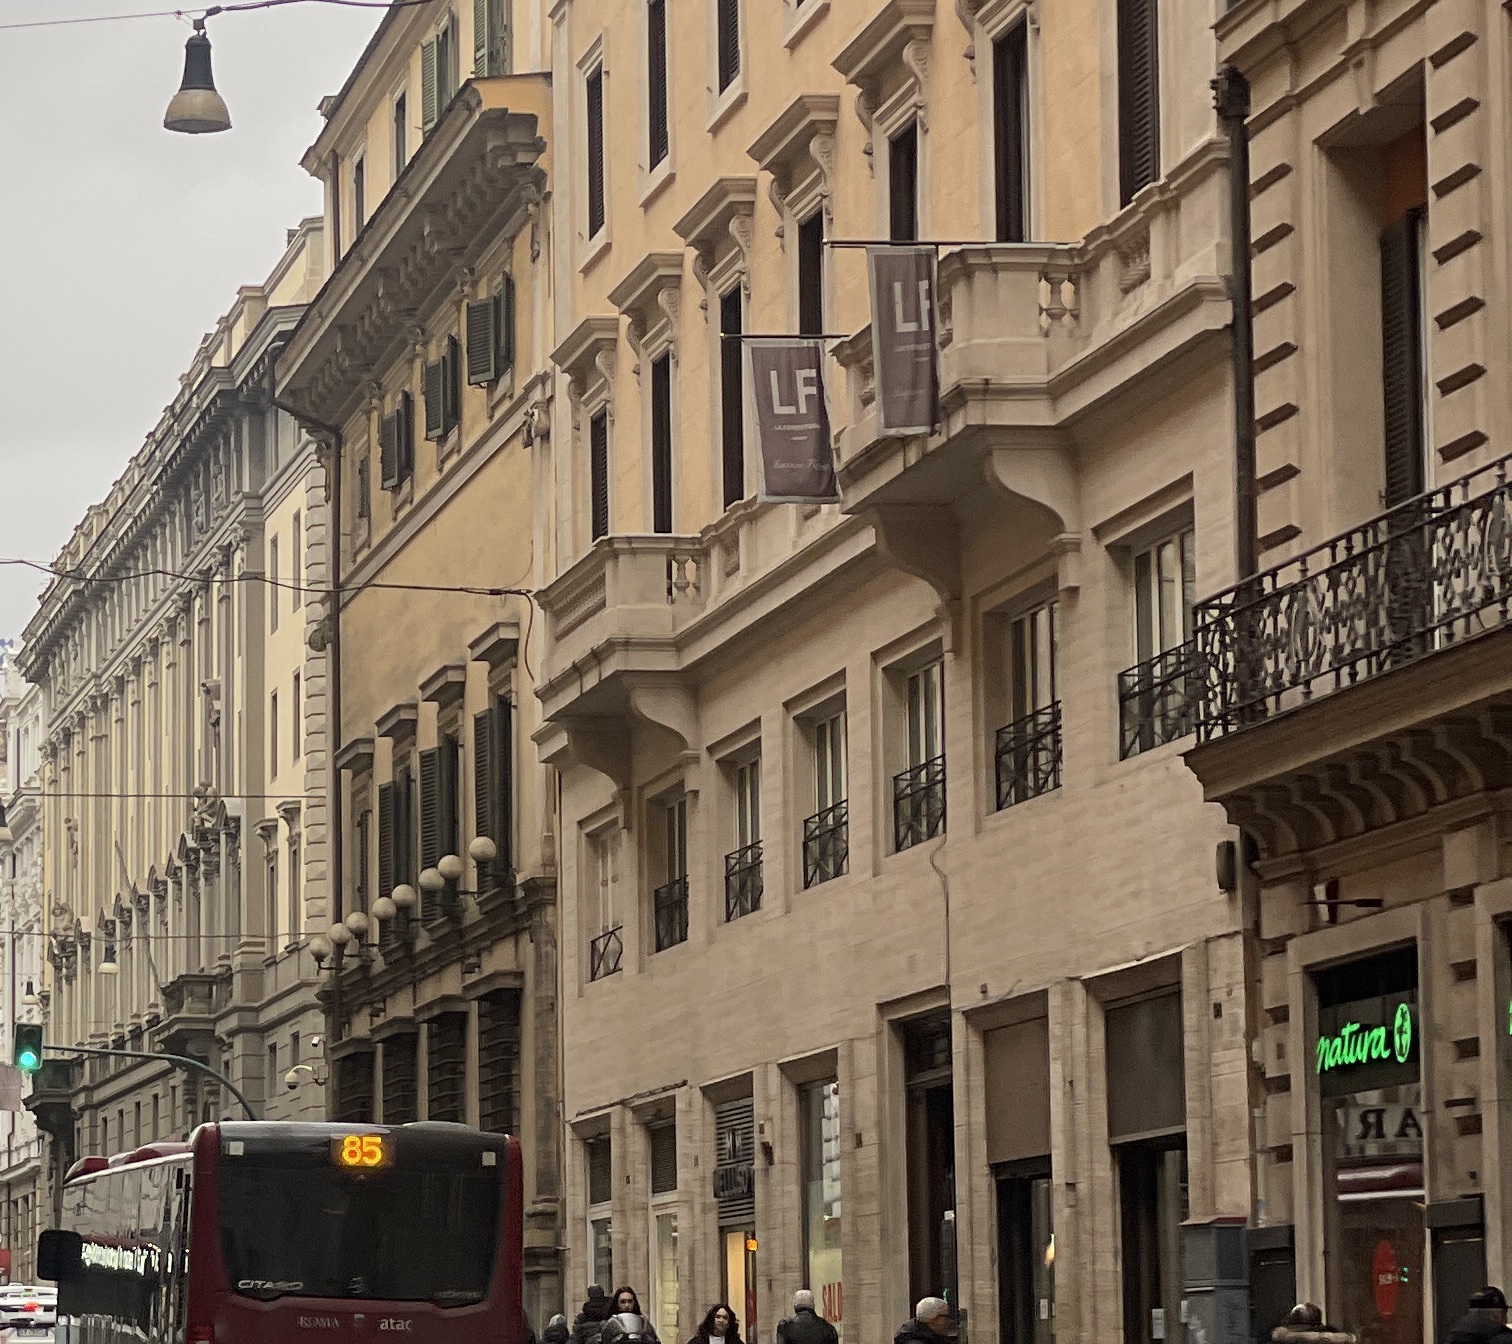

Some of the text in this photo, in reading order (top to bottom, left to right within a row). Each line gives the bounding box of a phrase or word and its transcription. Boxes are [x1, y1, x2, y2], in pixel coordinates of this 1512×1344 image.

[769, 368, 817, 415] LF
[1316, 1020, 1391, 1074] natura
[341, 1134, 384, 1168] 85
[378, 1317, 413, 1331] atac
